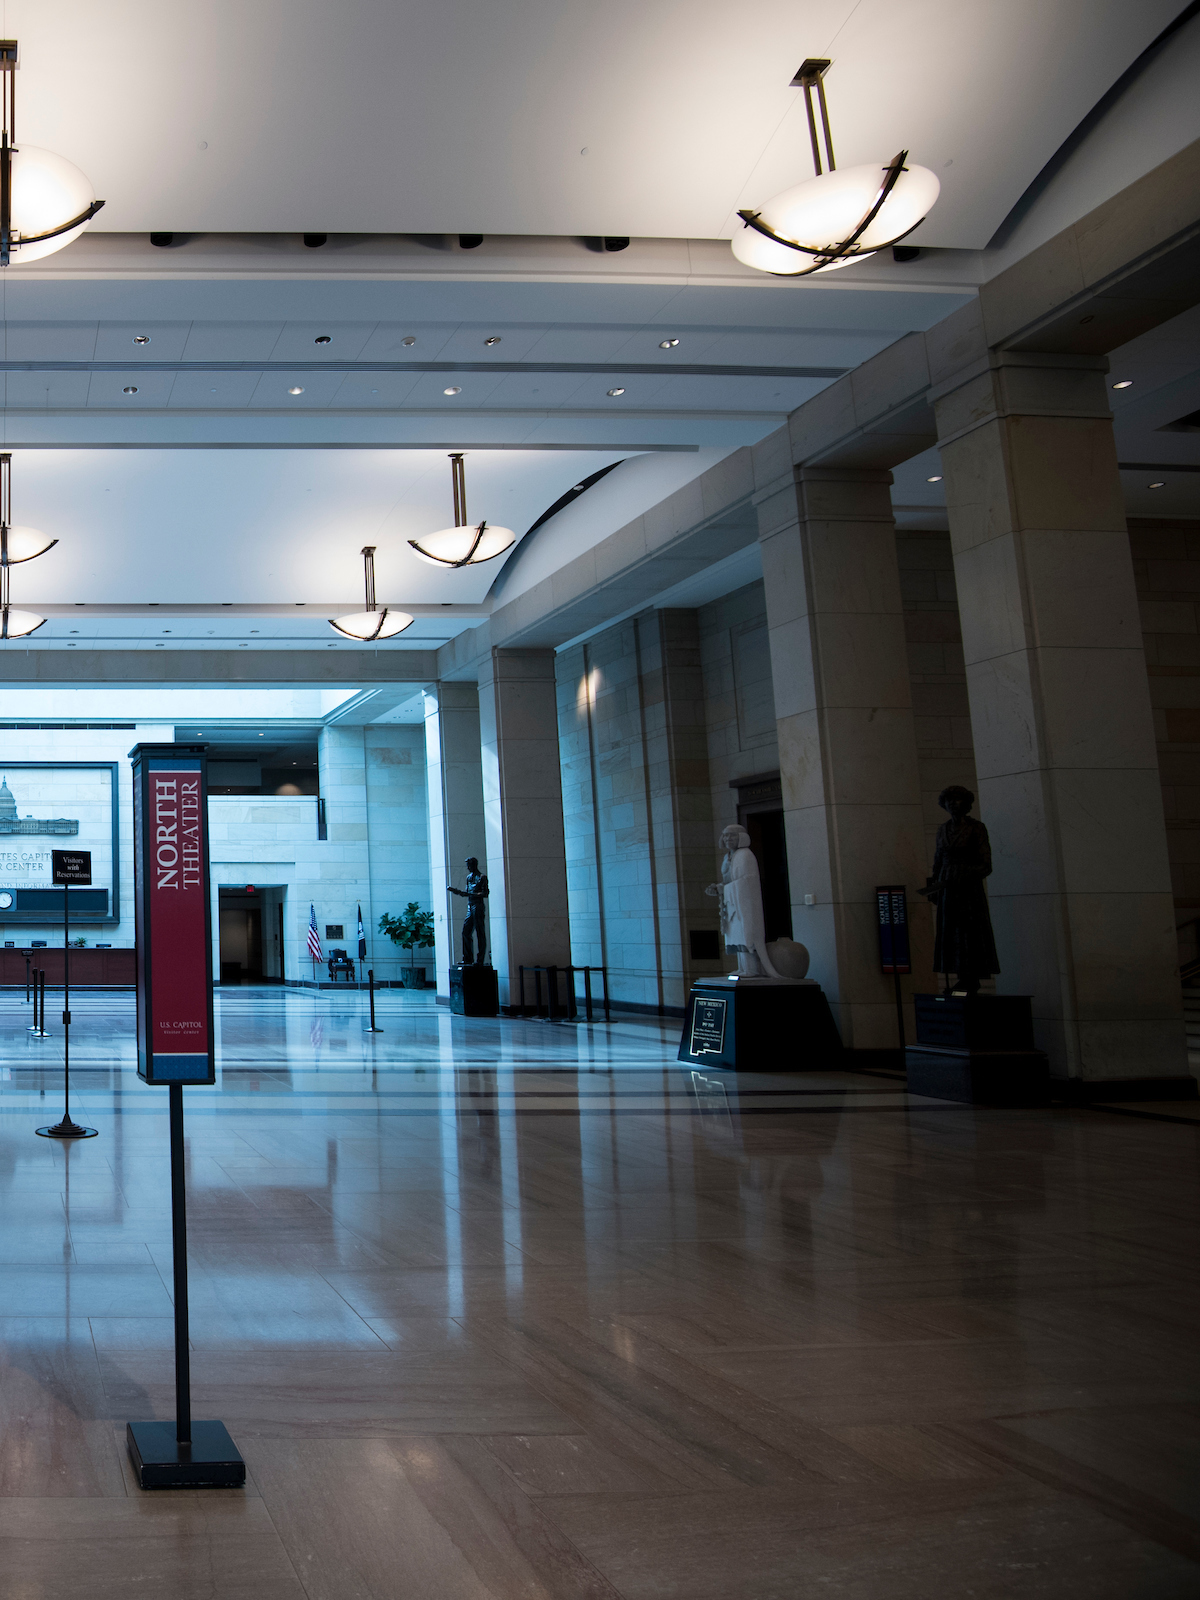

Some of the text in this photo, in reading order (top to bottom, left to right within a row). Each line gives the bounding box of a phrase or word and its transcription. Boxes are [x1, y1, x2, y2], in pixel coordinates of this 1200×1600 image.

[155, 779, 180, 890] NORTH
[181, 780, 200, 890] THEATER
[20, 852, 53, 861] CAPIT
[62, 856, 84, 864] Visitors
[5, 862, 44, 871] CENTER
[878, 895, 886, 925] SOUTH
[891, 895, 899, 925] SOUTH
[173, 1021, 203, 1029] CAPITOL
